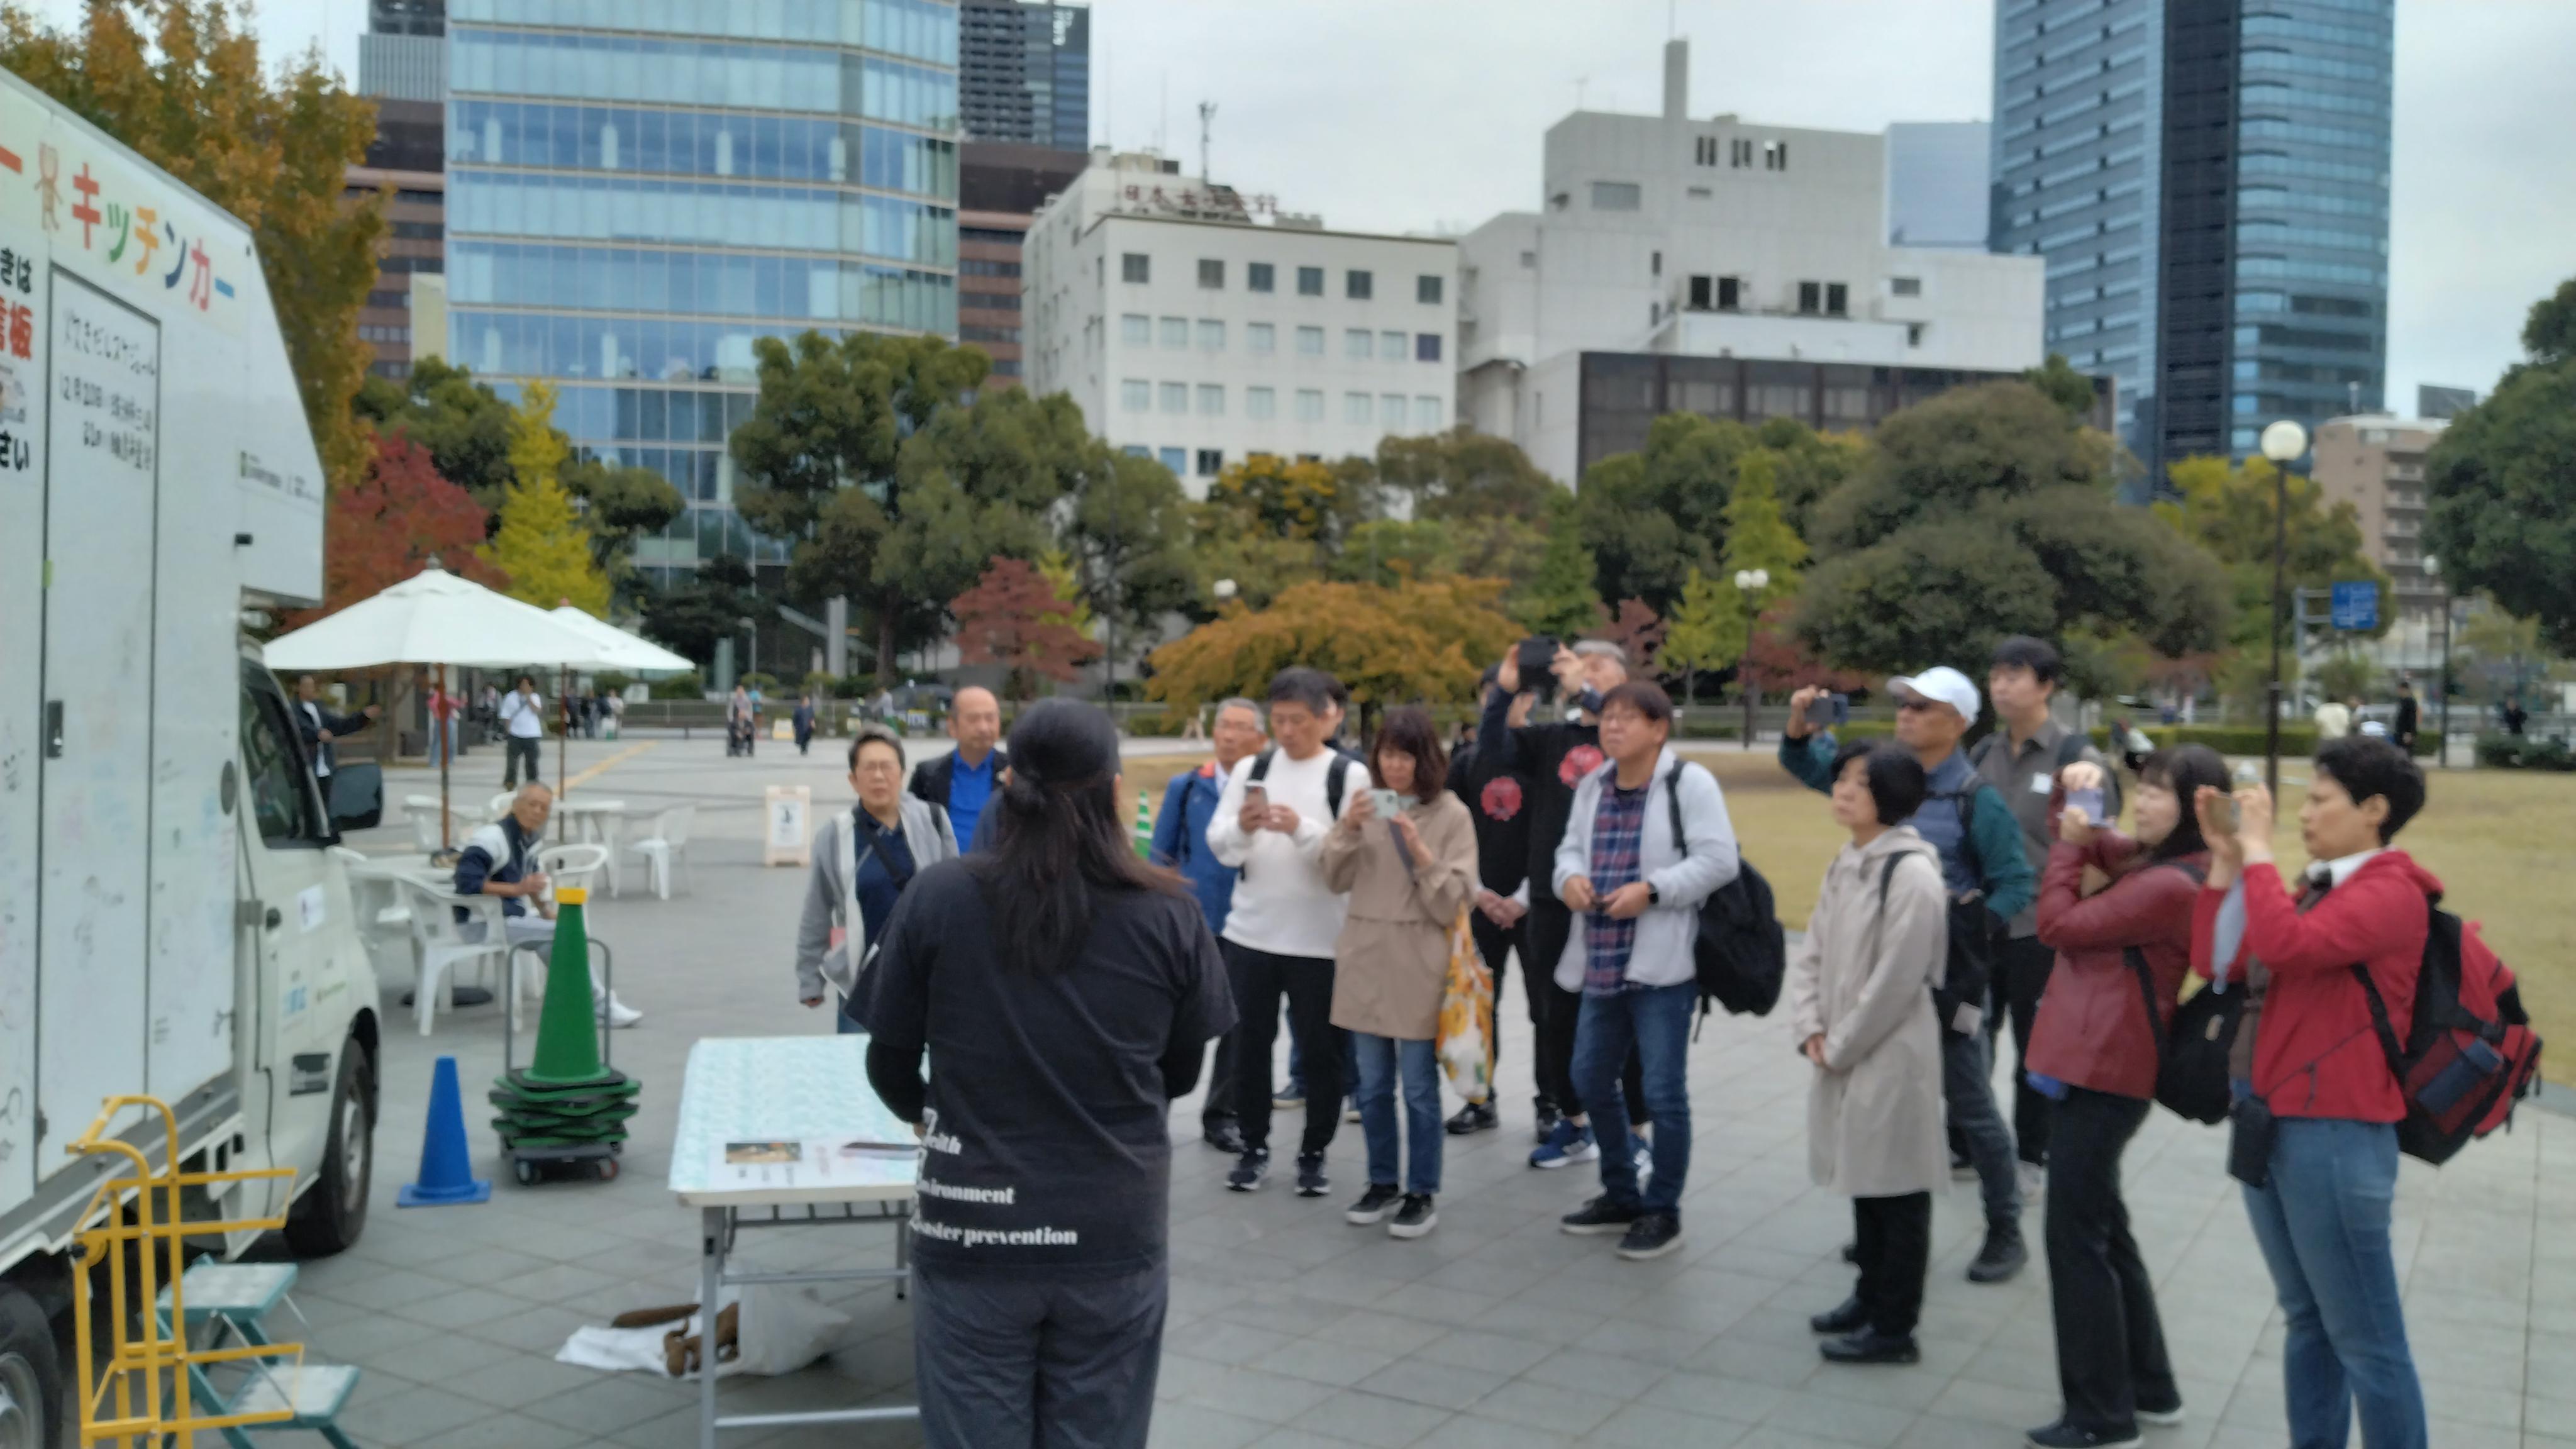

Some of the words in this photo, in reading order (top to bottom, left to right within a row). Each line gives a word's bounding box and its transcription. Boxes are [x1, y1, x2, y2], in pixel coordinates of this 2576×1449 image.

[71, 162, 235, 312] キッチンカー
[963, 1225, 1078, 1248] prevention
